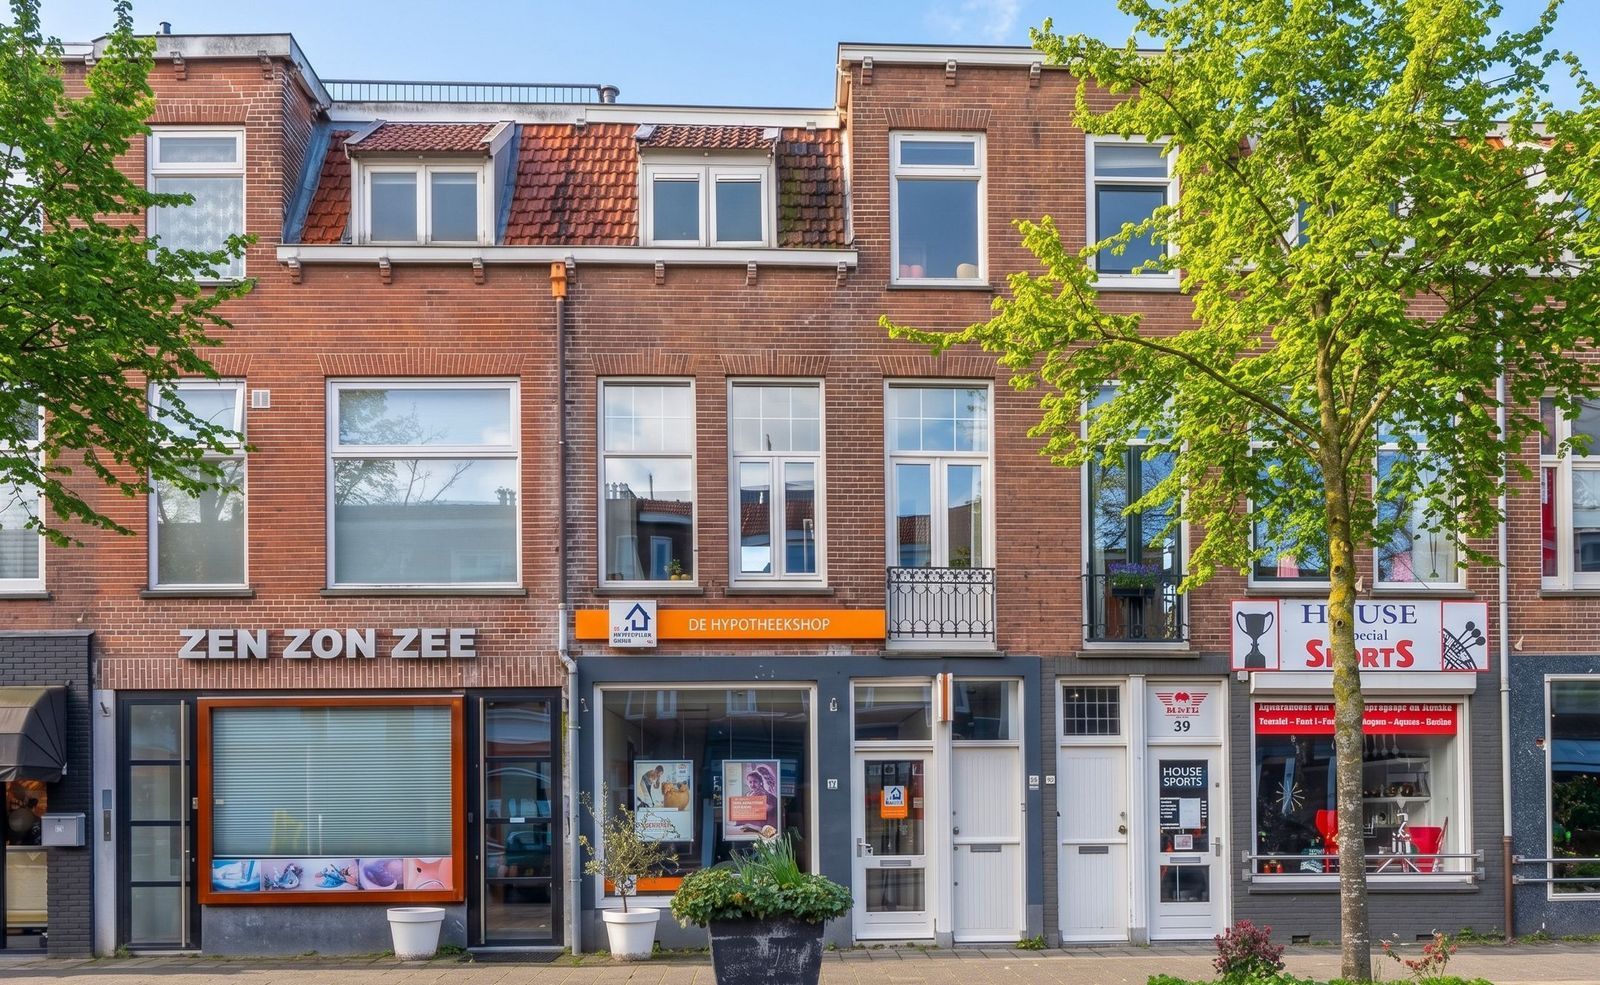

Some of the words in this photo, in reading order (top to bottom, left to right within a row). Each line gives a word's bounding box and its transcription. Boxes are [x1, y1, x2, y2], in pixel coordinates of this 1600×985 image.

[1300, 604, 1418, 625] HUSE
[688, 618, 707, 631] DE
[711, 618, 830, 631] HYPOTHEEKSHOP
[178, 628, 268, 659] ZEN
[282, 628, 376, 659] ZON
[391, 628, 476, 658] ZEE
[1174, 720, 1191, 732] 39
[1163, 767, 1203, 777] HOUSE
[1163, 777, 1203, 787] SPORTS
